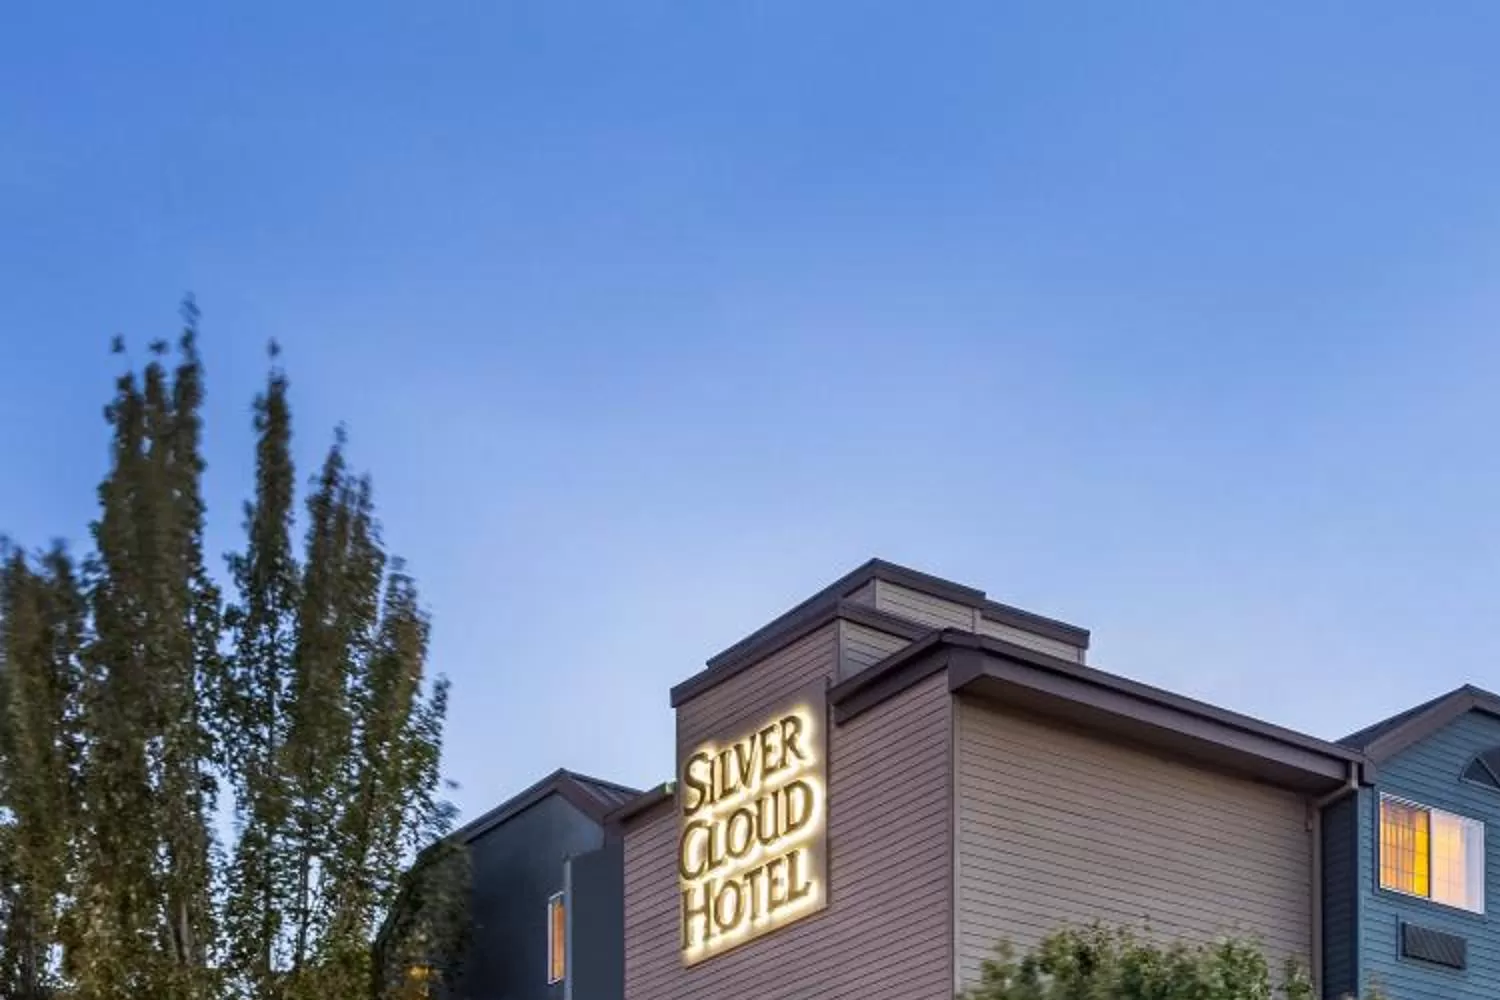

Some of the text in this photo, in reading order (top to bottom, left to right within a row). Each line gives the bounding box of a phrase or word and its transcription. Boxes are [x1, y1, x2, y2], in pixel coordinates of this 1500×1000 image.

[684, 715, 806, 816] SILVER
[679, 780, 814, 880] CLOUD
[681, 850, 811, 950] HOTEL
